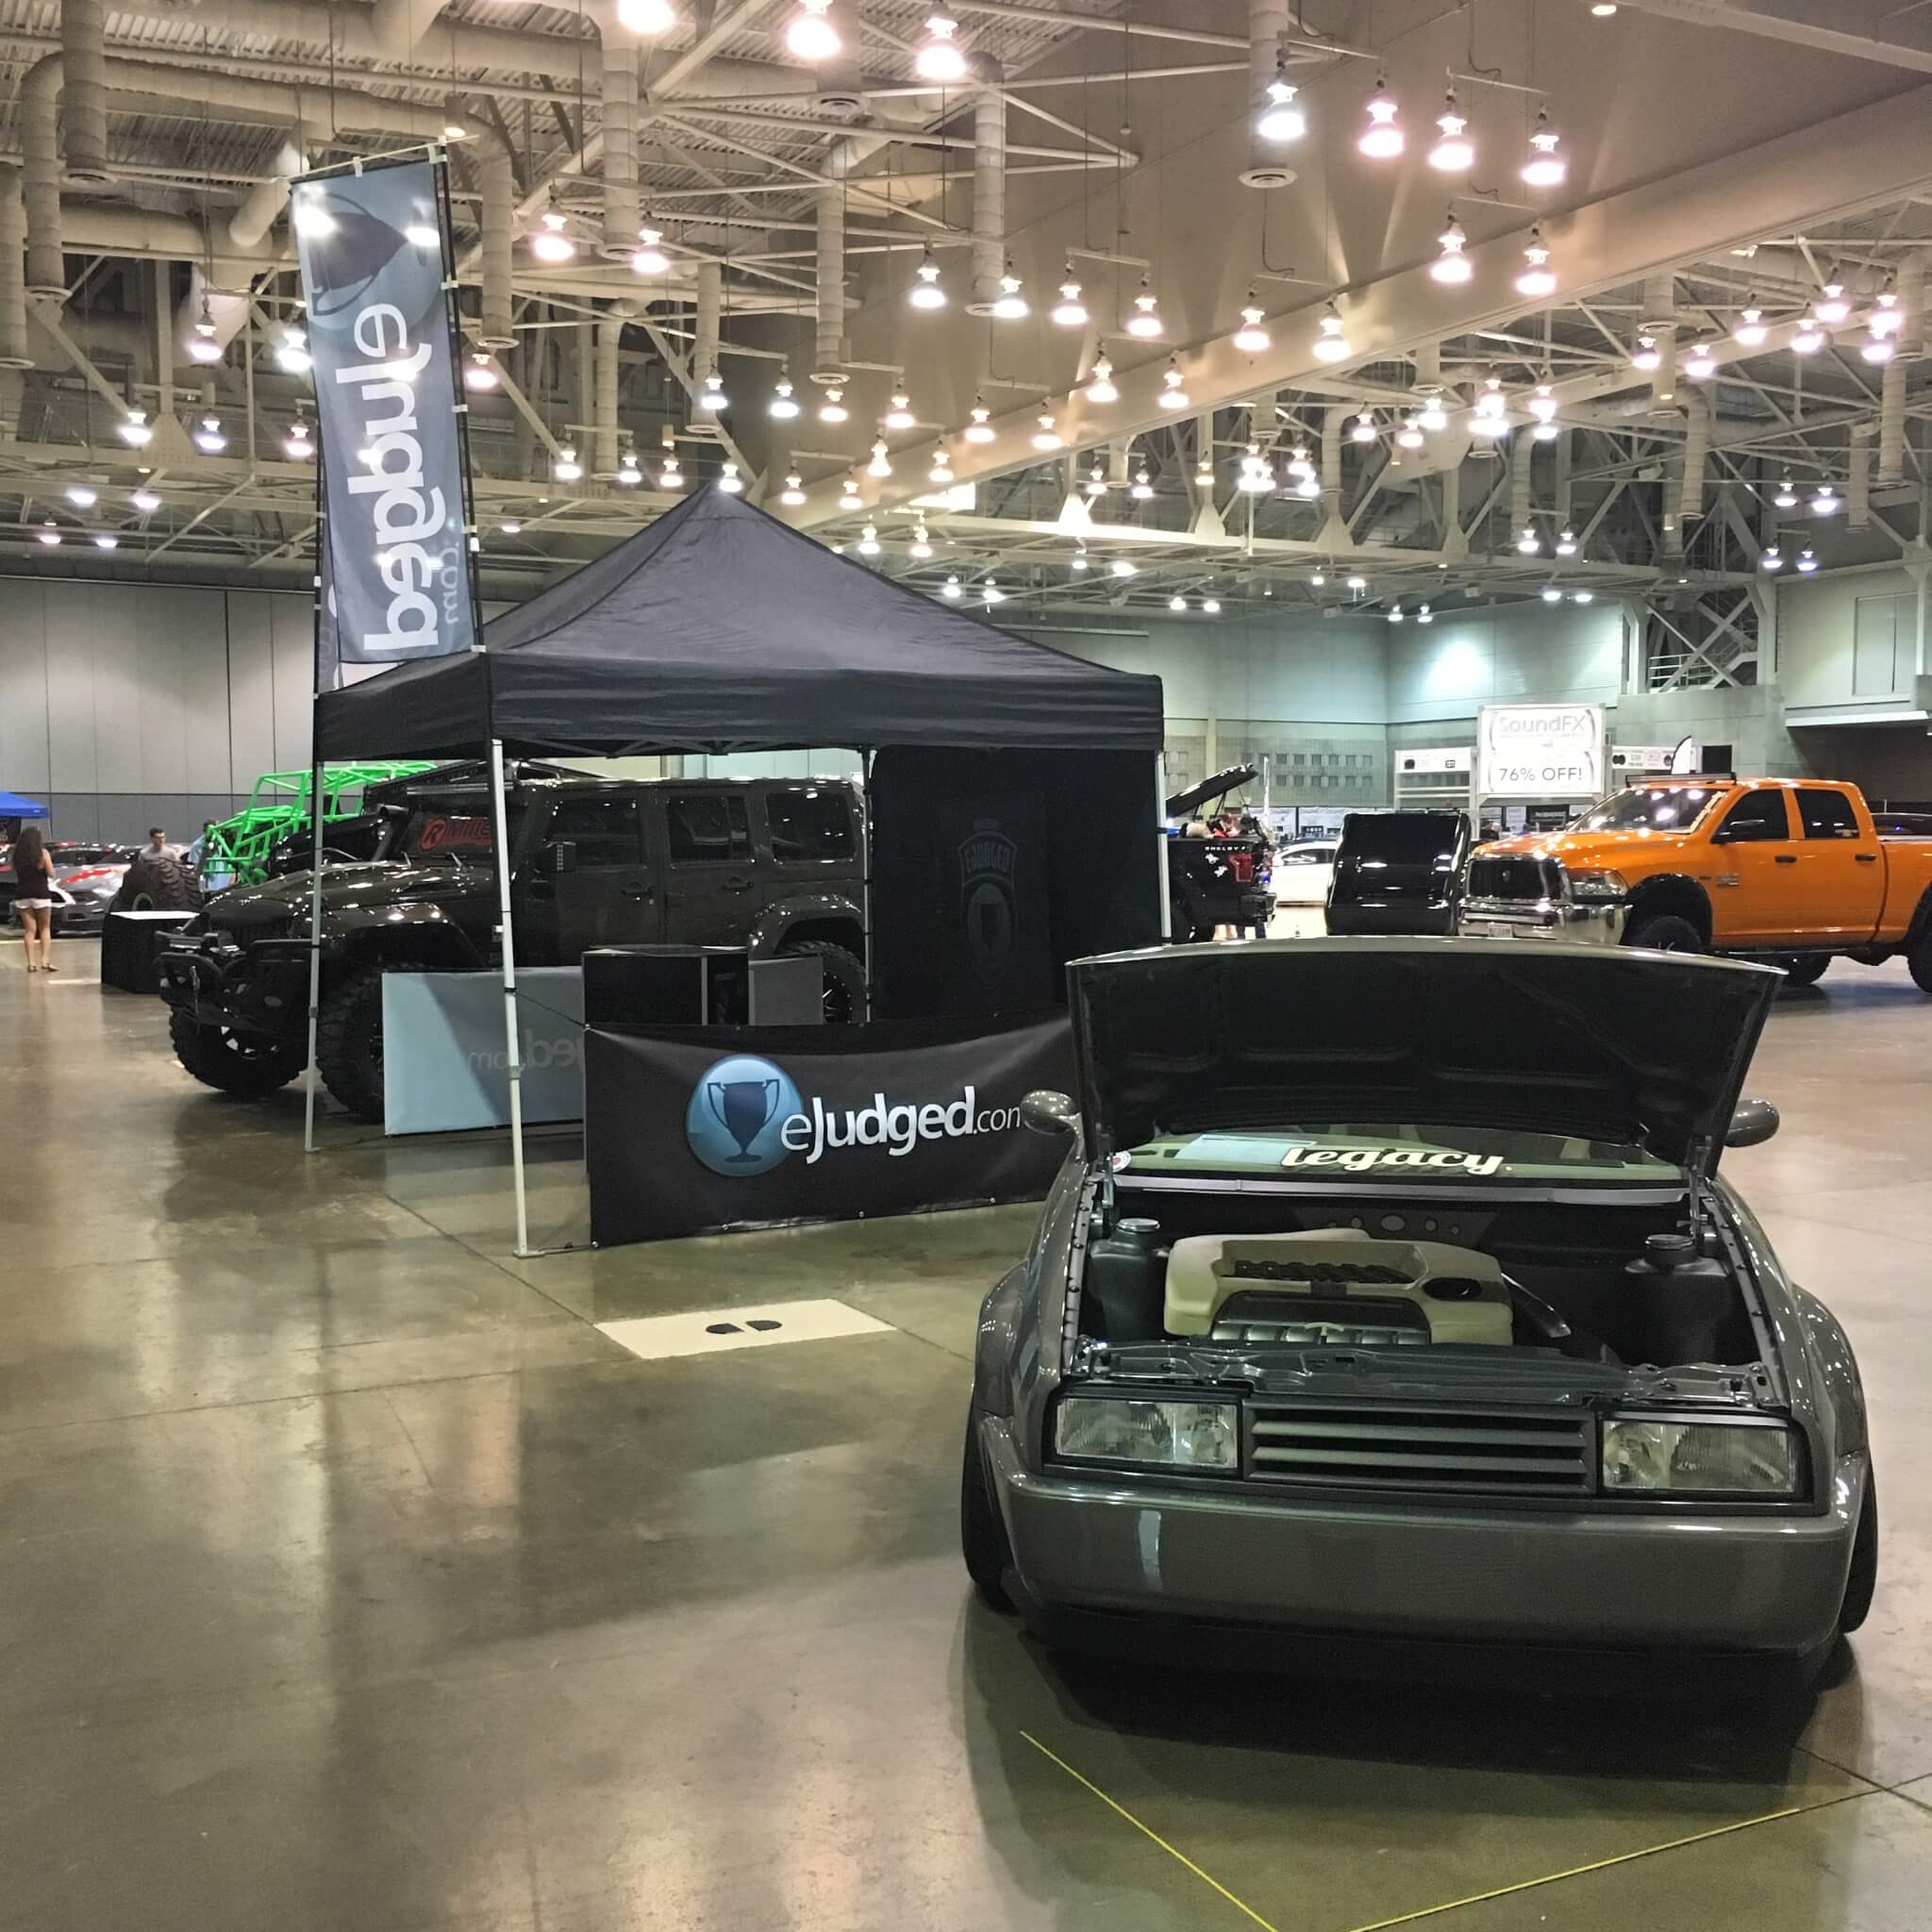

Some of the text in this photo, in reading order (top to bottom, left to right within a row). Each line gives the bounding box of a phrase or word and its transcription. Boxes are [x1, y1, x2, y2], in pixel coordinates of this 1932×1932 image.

[1498, 715, 1587, 733] SoundFX
[1498, 767, 1583, 781] 76% OFF!
